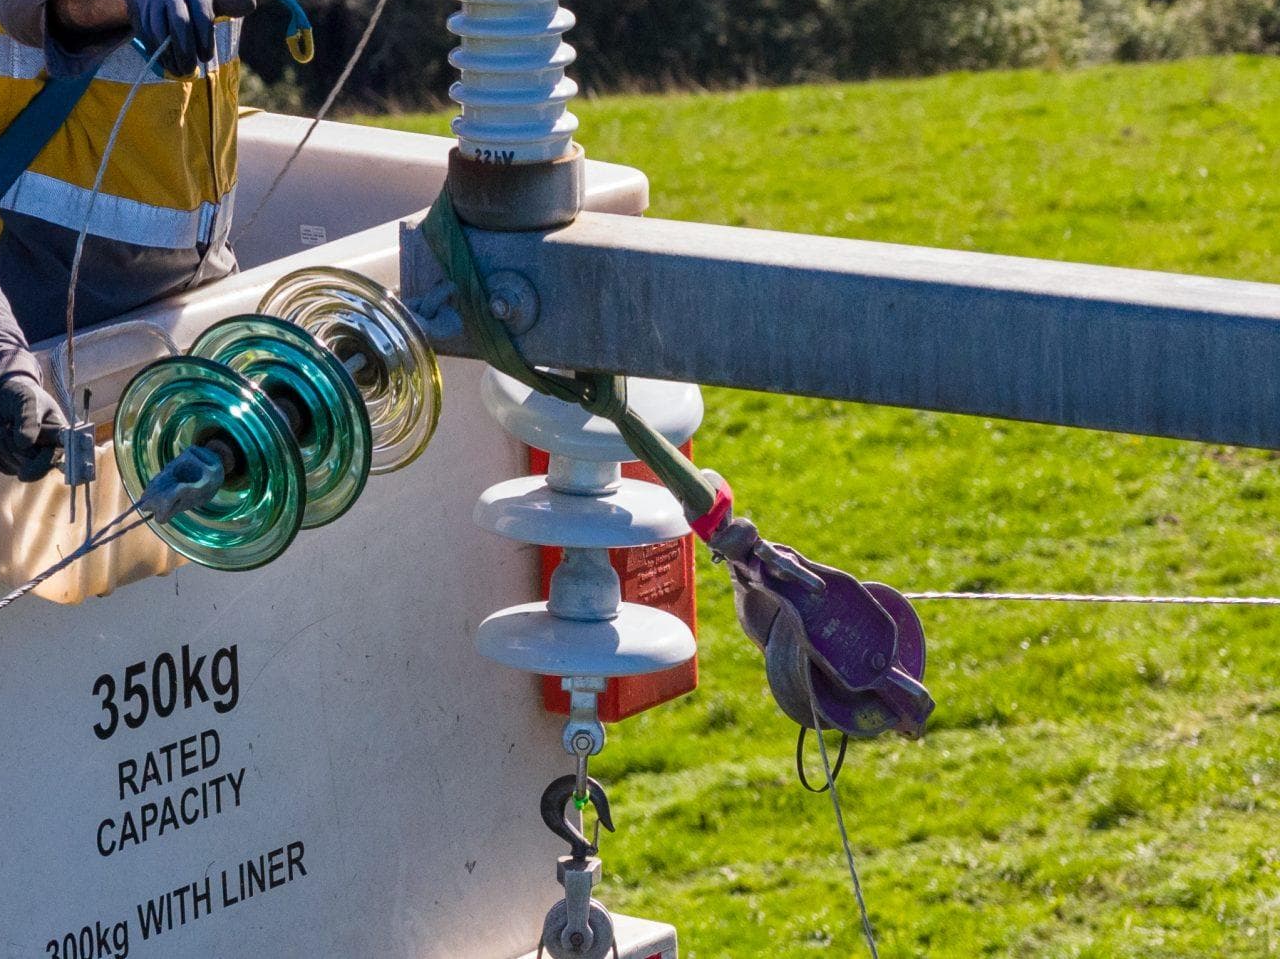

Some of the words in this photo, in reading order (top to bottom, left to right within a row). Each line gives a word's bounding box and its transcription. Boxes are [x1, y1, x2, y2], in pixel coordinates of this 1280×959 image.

[92, 644, 240, 741] 350kg
[118, 729, 221, 800] RATED
[96, 768, 246, 857] CAPACITY
[137, 876, 212, 940] WITH
[221, 841, 308, 908] LINER
